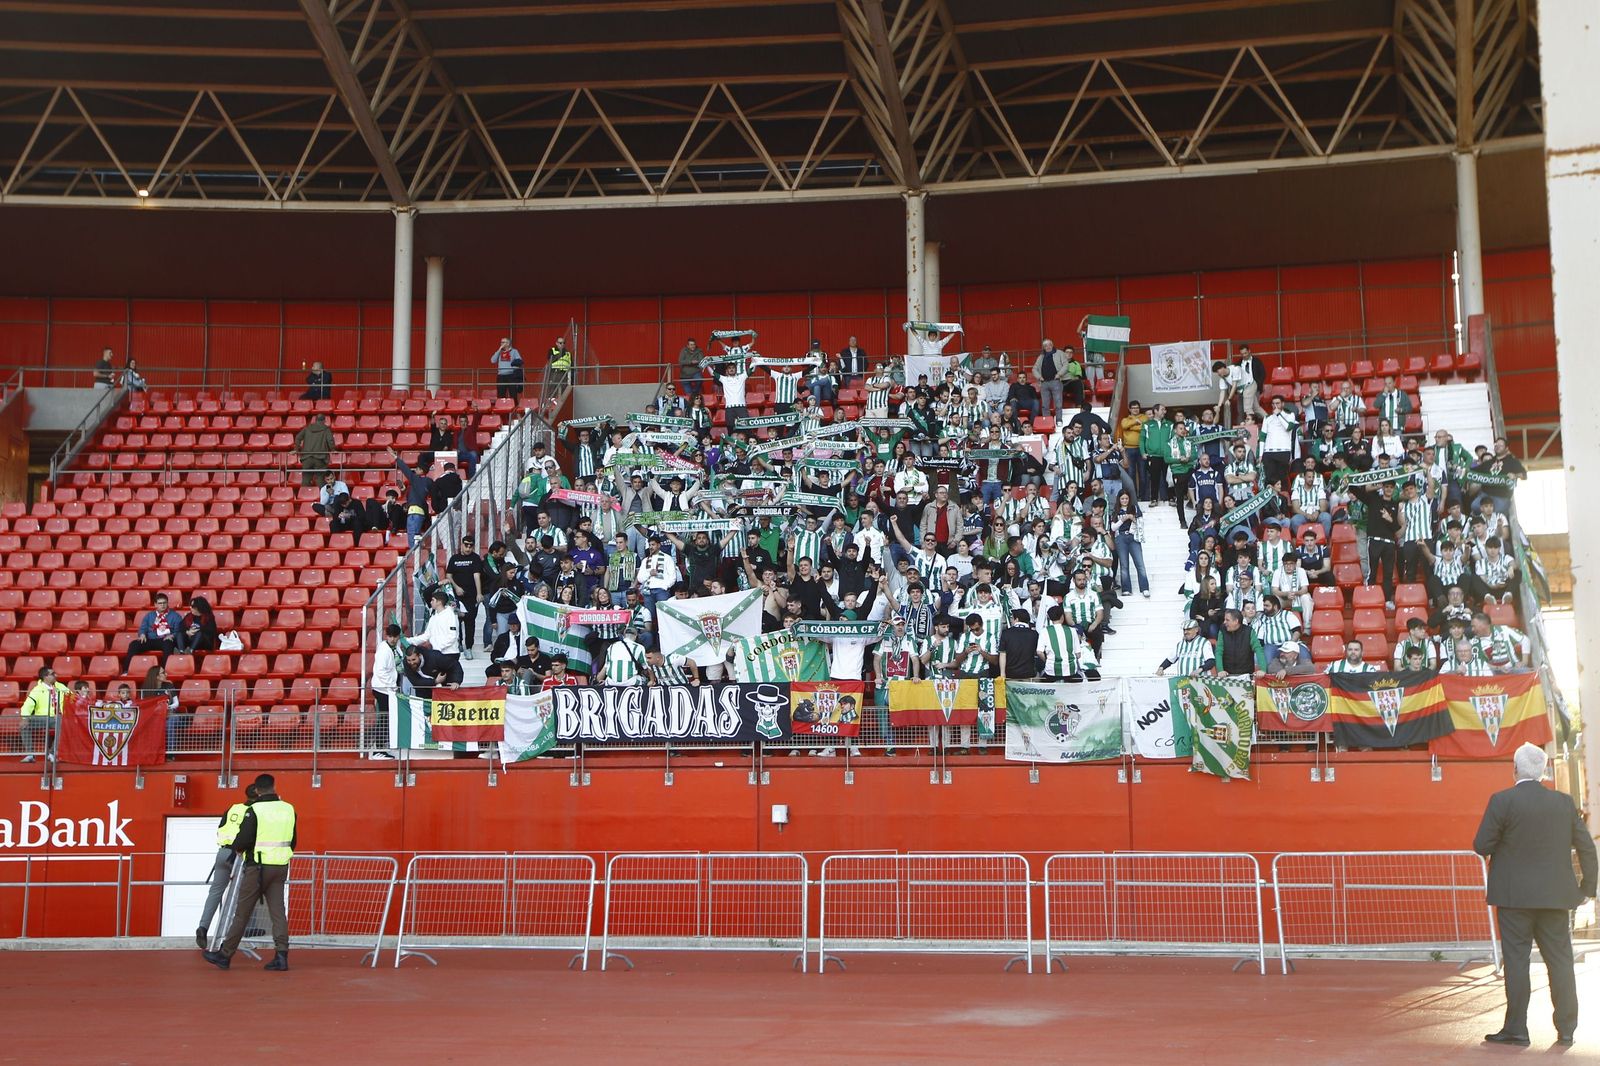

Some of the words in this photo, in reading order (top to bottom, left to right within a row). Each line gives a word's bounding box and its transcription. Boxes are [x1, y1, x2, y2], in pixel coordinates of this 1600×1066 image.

[786, 414, 796, 422] CF
[783, 507, 791, 515] CF
[691, 522, 707, 531] CRUZ
[708, 521, 729, 530] CONDE
[612, 613, 621, 621] CF
[810, 623, 858, 634] CÓRDOBA
[861, 625, 875, 633] CF
[96, 711, 105, 719] U
[437, 702, 501, 723] Baena
[555, 686, 742, 740] BRIGADAS
[94, 722, 130, 730] ALMERIA
[810, 724, 839, 734] 14600
